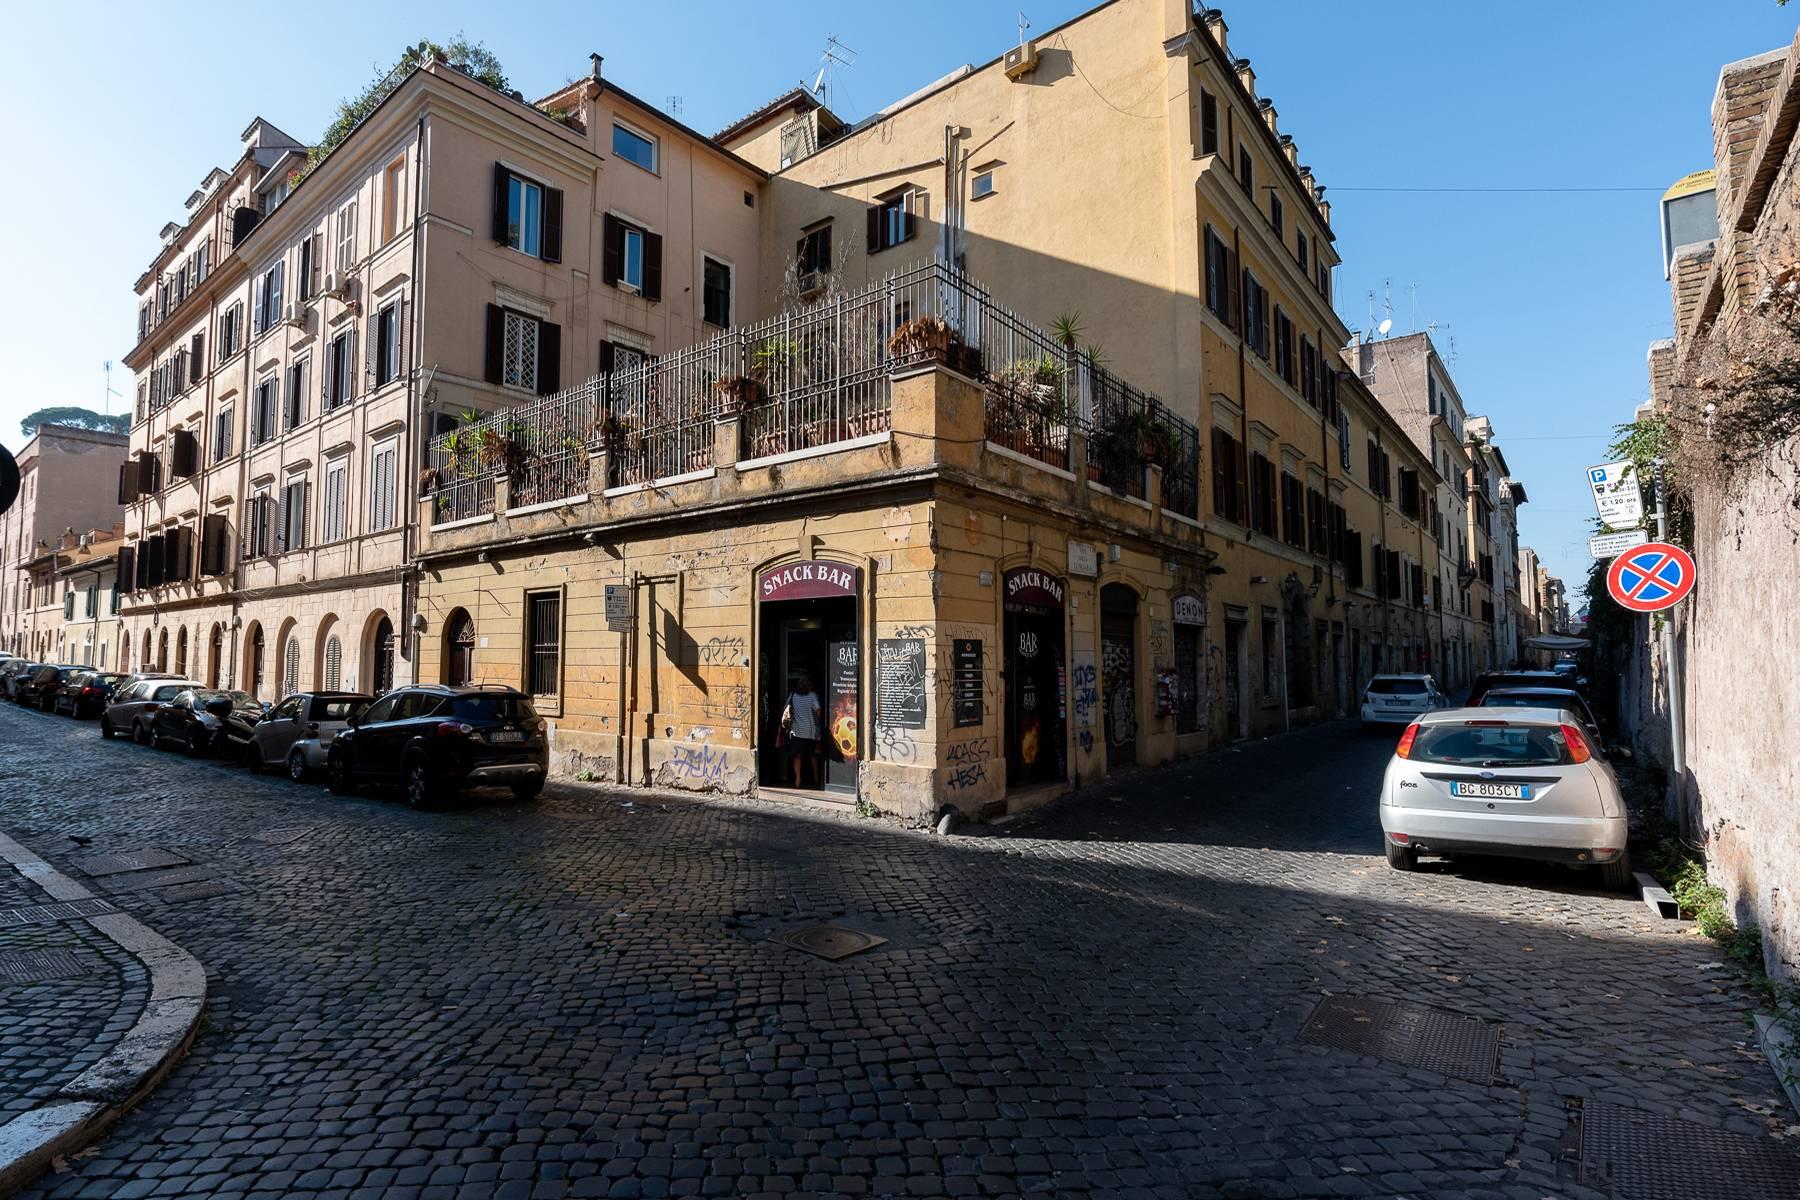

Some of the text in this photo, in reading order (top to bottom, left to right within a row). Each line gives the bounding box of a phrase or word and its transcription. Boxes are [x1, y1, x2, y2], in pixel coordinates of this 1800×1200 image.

[1594, 471, 1603, 481] P
[763, 565, 852, 596] SNACK BAR
[1008, 572, 1063, 603] SNACK BAR
[905, 642, 920, 652] BAR
[1020, 631, 1037, 652] BAR
[839, 647, 857, 662] BAR
[1459, 783, 1519, 796] BG 803CY
